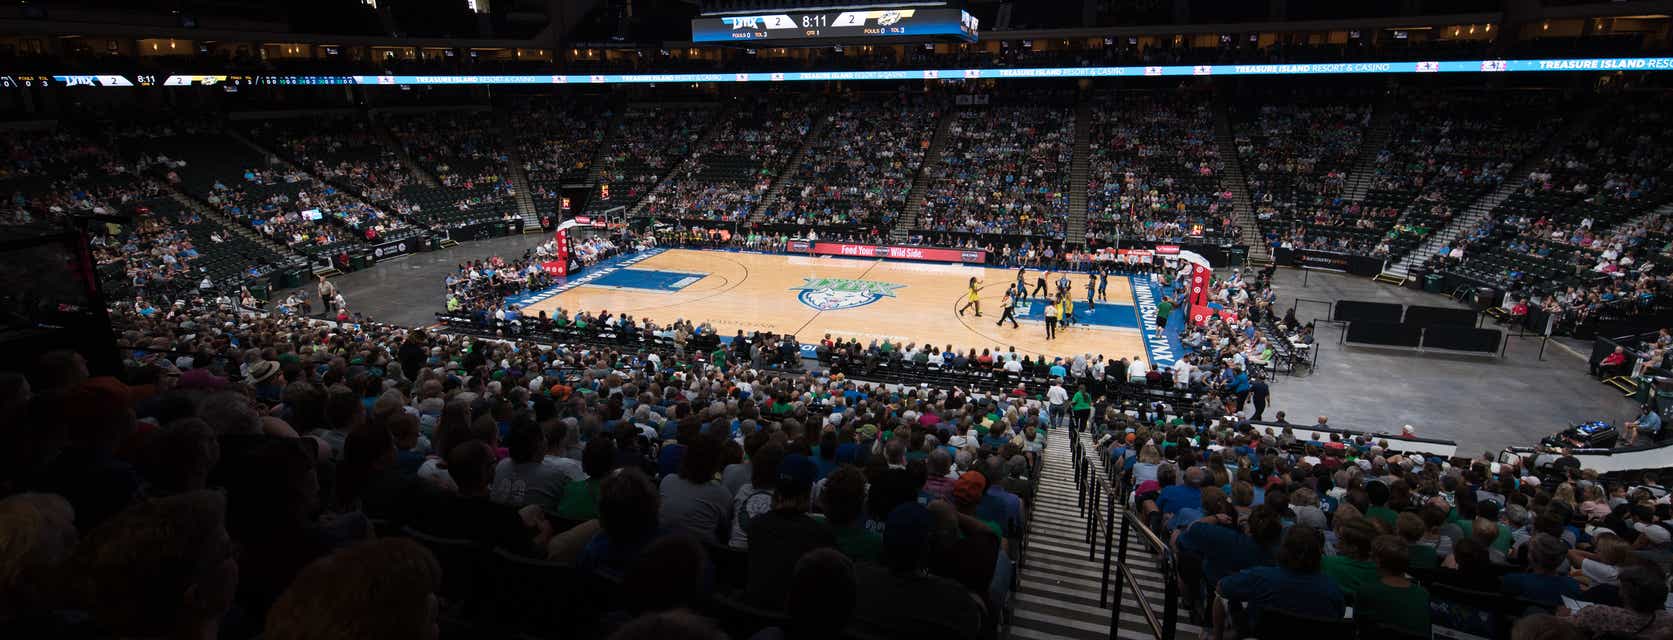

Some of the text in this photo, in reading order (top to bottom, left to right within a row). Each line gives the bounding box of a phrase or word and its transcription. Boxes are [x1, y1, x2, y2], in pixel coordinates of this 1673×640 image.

[775, 17, 781, 26] 2
[802, 15, 827, 28] 8:11
[849, 15, 855, 24] 2
[1235, 65, 1277, 73] TREASURE
[1278, 64, 1310, 72] ISLAND
[1312, 64, 1345, 72] RESORT
[1355, 63, 1390, 72] CASINO
[1539, 60, 1598, 69] TREASURE
[1600, 59, 1645, 69] ISLAND
[1035, 69, 1061, 77] ISLAND
[1063, 68, 1088, 76] RESORT
[111, 77, 118, 85] 2
[137, 75, 155, 83] 8:11
[176, 77, 183, 85] 2
[841, 244, 857, 255] Feed
[858, 245, 873, 256] Your
[890, 247, 905, 257] Wild
[906, 248, 923, 258] Side.
[1148, 334, 1175, 362] LYNX
